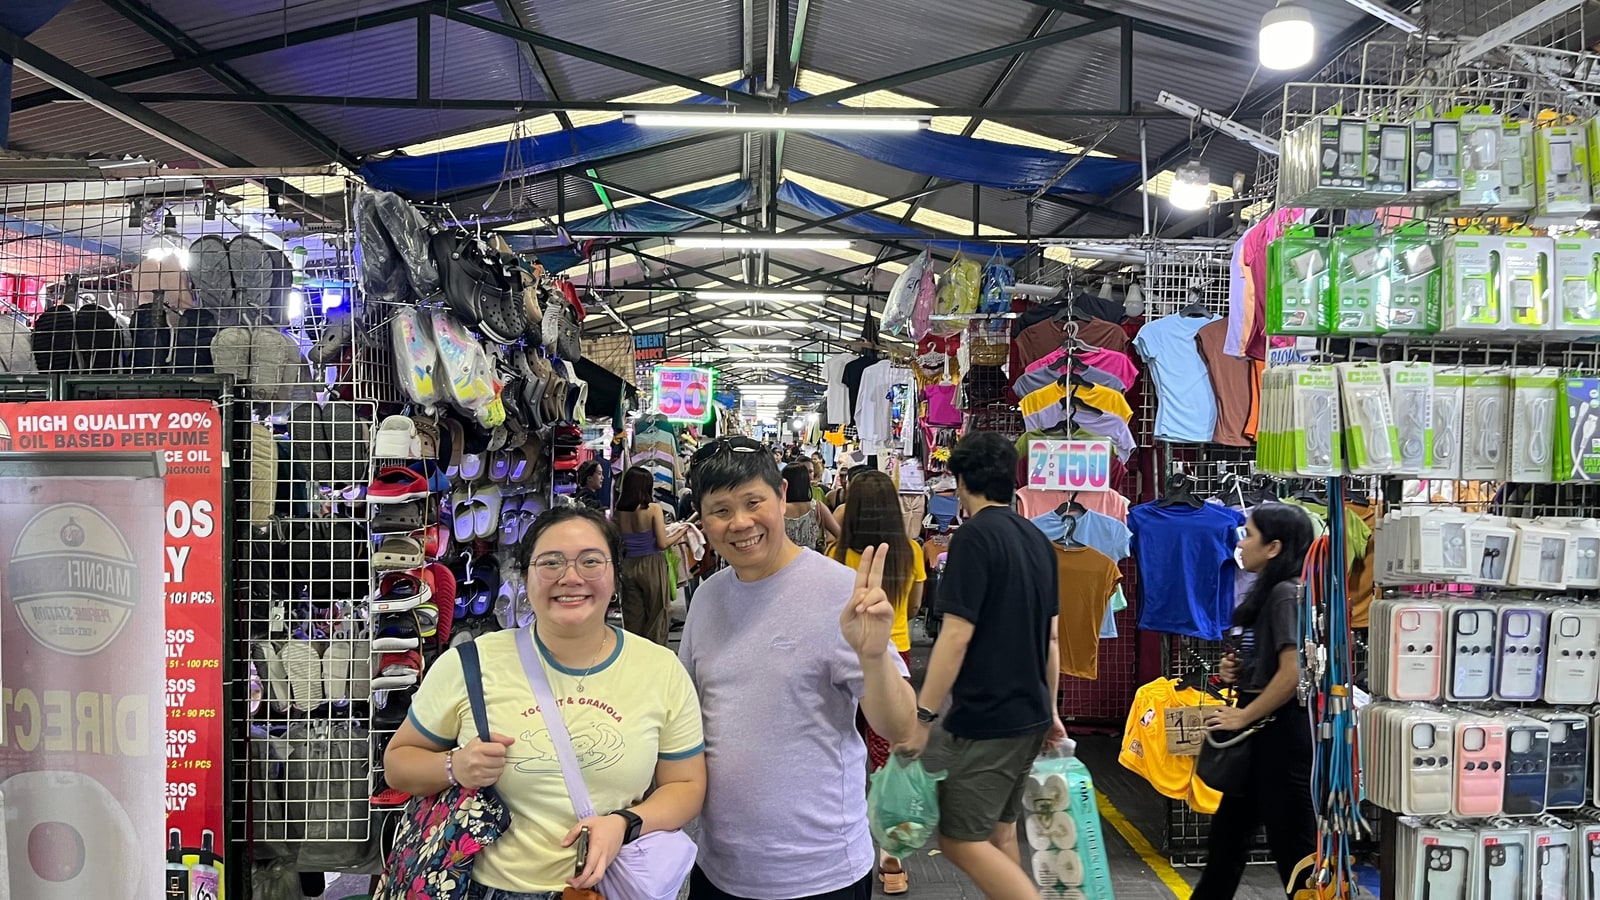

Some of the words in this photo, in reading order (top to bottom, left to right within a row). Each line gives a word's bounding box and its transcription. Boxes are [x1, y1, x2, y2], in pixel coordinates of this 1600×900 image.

[658, 381, 708, 415] 50
[18, 415, 68, 432] HIGH
[74, 413, 162, 431] QUALITY
[168, 412, 212, 430] 20%
[19, 434, 48, 449] OIL
[54, 433, 115, 448] BASED
[121, 431, 210, 446] PERFUME
[187, 450, 212, 462] OIL
[1030, 442, 1048, 484] 2
[1055, 444, 1108, 488] 150
[170, 592, 188, 604] 101
[190, 591, 216, 604] PCS.
[170, 660, 179, 668] 51
[187, 660, 200, 668] 100
[202, 659, 219, 668] PCS
[172, 709, 181, 718] 12
[200, 708, 216, 718] PCS
[578, 698, 622, 722] GRANOLA
[172, 760, 178, 768] 2
[195, 760, 212, 768] PCS
